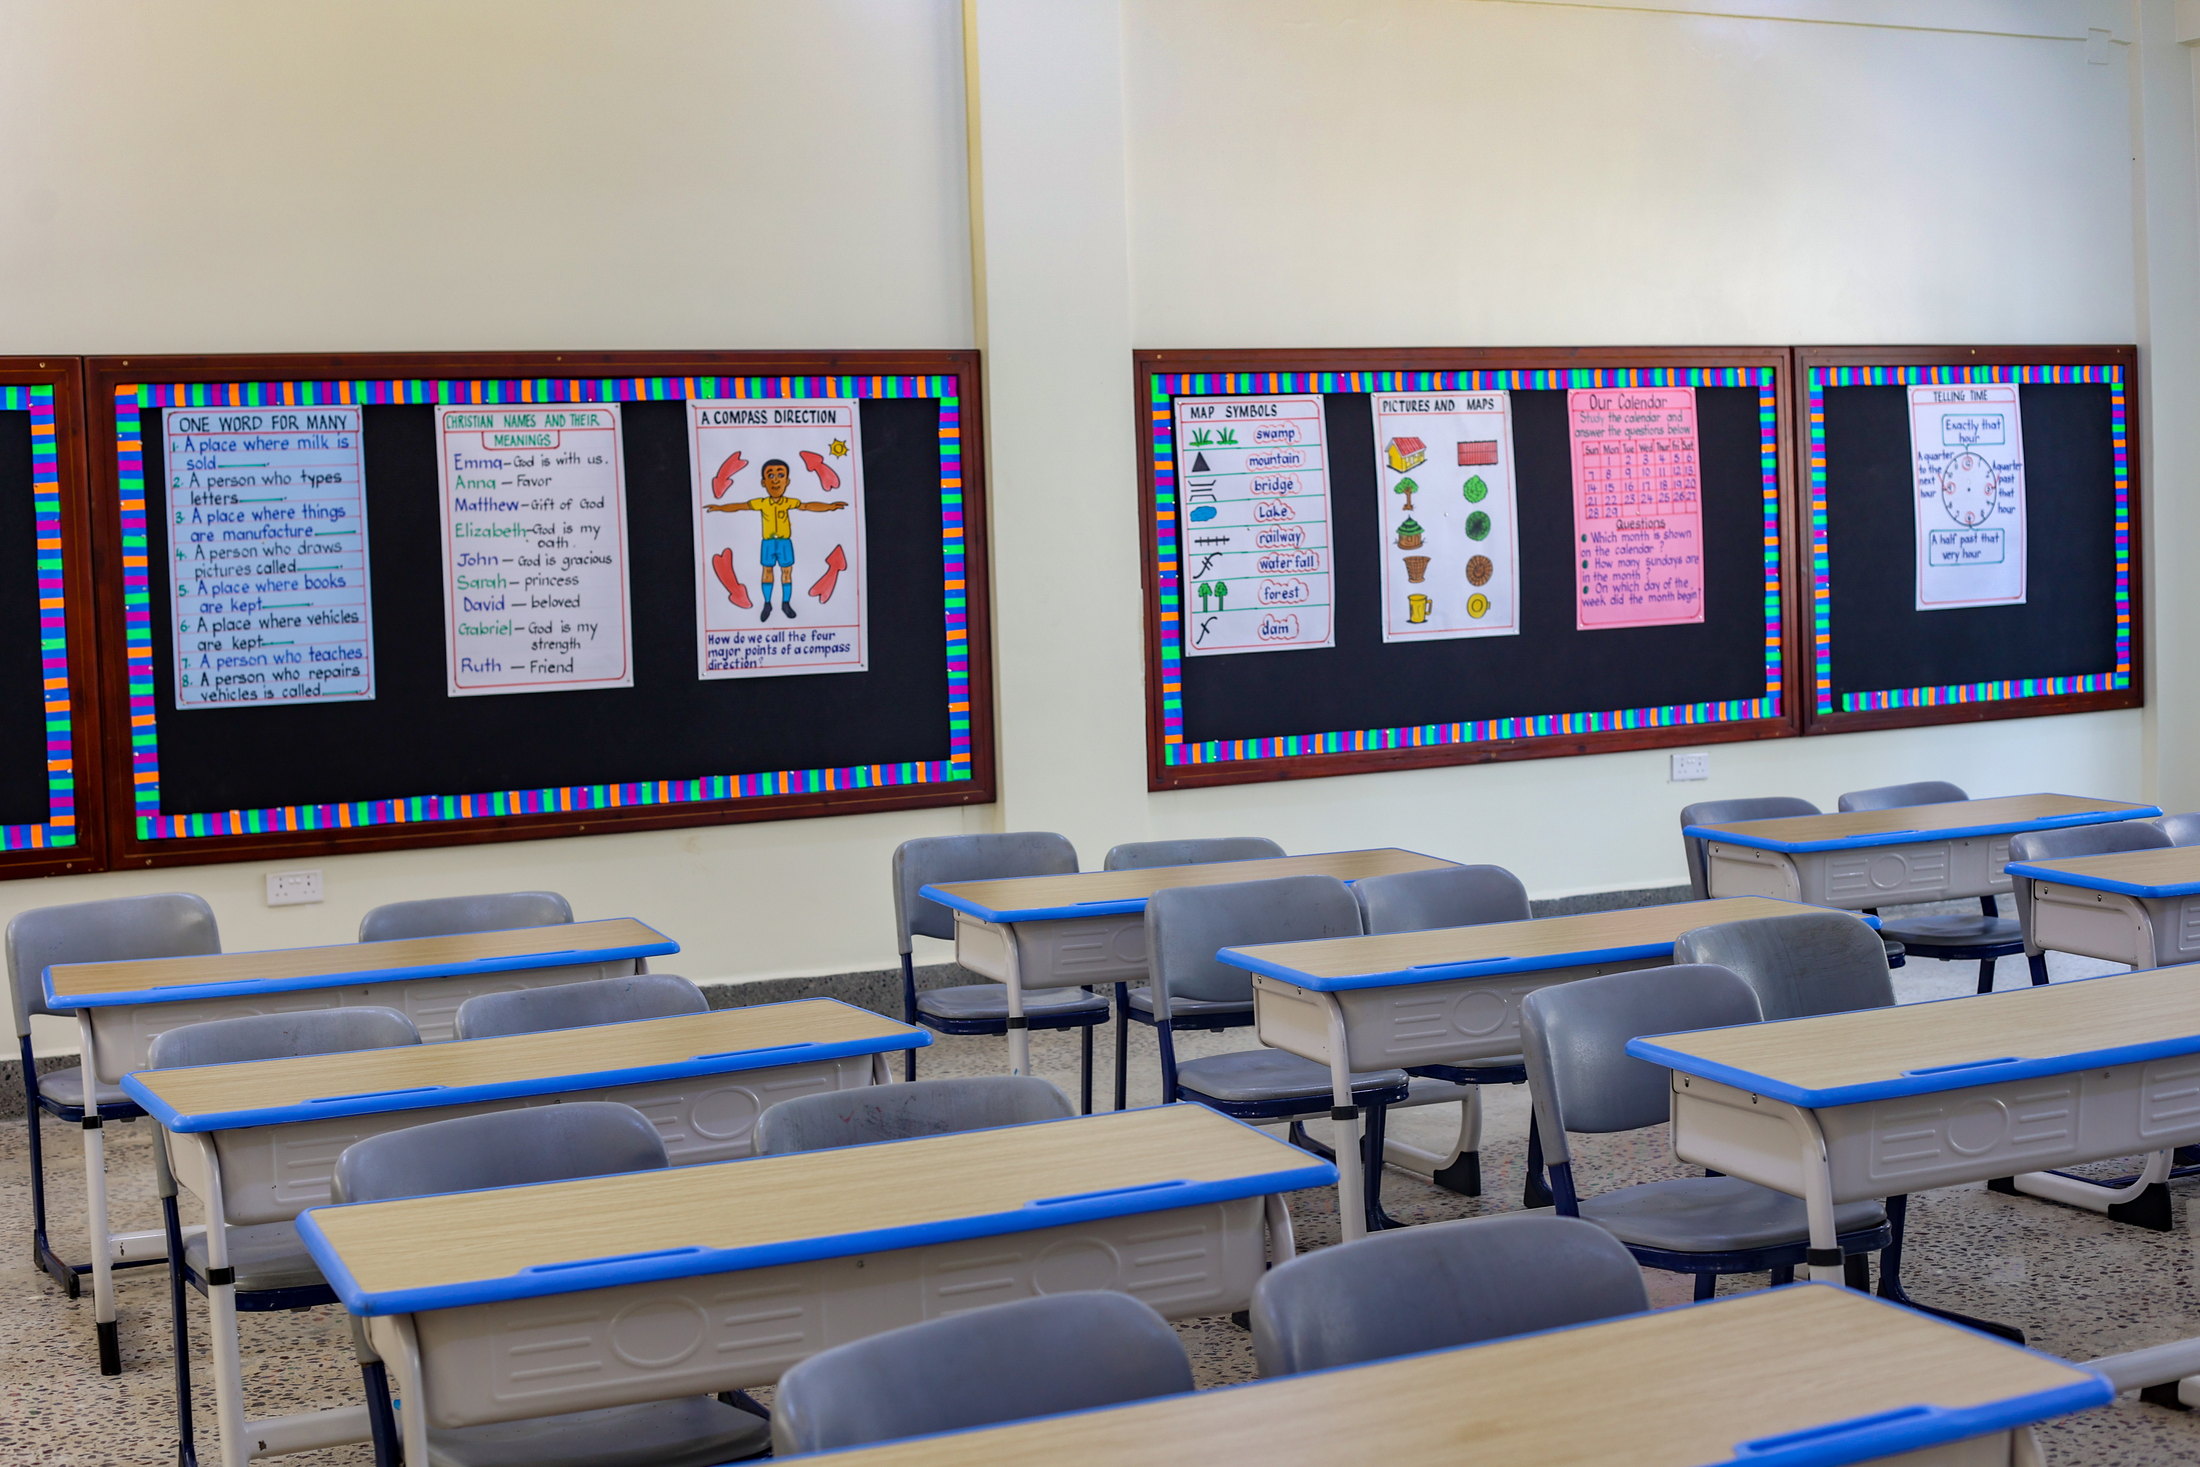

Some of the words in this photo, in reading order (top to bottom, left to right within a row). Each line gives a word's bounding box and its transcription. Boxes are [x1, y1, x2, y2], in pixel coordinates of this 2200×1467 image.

[1590, 394, 1612, 410] Our
[1618, 393, 1667, 409] Calendar
[1933, 391, 1965, 402] TELLING
[1970, 390, 1988, 401] TIME
[1191, 406, 1214, 418] MAP
[1226, 404, 1277, 418] SYMBOLS
[1383, 400, 1430, 412] PICTURES
[1435, 400, 1455, 411] AND
[1467, 399, 1494, 409] MAPS
[180, 417, 209, 432] ONE
[219, 416, 262, 431] WORD
[272, 415, 299, 430] FOR
[307, 415, 347, 430] MANY
[447, 415, 493, 428] CHRISTIAN
[504, 415, 535, 428] NAMES
[545, 414, 566, 427] AND
[570, 414, 599, 426] THEIR
[702, 412, 709, 424] A
[714, 410, 767, 424] COMPASS
[775, 410, 836, 423] DIRECTION
[1580, 411, 1604, 425] Study
[1609, 412, 1621, 422] the
[1625, 413, 1660, 423] calendar
[1667, 410, 1682, 421] and
[1575, 429, 1605, 437] answer
[1609, 425, 1621, 436] the
[1625, 426, 1664, 440] questions
[1668, 425, 1690, 434] below
[1946, 419, 1978, 435] Exactly
[1982, 419, 2001, 429] that
[494, 434, 550, 446] MEANINGS
[1257, 430, 1295, 442] swamp
[1959, 433, 1979, 442] hour
[185, 436, 195, 452] A
[200, 439, 236, 457] place
[243, 436, 288, 451] where
[298, 434, 328, 449] milk
[338, 433, 348, 448] is
[542, 454, 550, 466] is
[556, 452, 580, 465] with
[1250, 453, 1299, 466] mountain
[189, 473, 200, 487] A
[208, 475, 255, 491] person
[262, 471, 291, 485] who
[302, 470, 342, 488] types
[456, 475, 496, 489] Anna
[517, 474, 552, 487] Favor
[1255, 478, 1293, 494] bridge
[560, 498, 571, 509] of
[580, 497, 604, 508] God
[192, 508, 202, 523] A
[207, 510, 244, 525] place
[252, 506, 295, 521] where
[302, 504, 345, 521] things
[563, 522, 572, 534] is
[581, 524, 600, 539] my
[1616, 519, 1665, 529] Questions
[191, 531, 214, 542] are
[1260, 529, 1301, 547] railway
[1591, 532, 1617, 543] Which
[1622, 532, 1649, 541] month
[1654, 531, 1660, 539] is
[1664, 529, 1691, 540] shown
[1932, 534, 1937, 545] A
[1940, 533, 1956, 544] half
[1960, 533, 1977, 548] past
[1981, 533, 1999, 543] that
[195, 545, 205, 560] A
[209, 546, 257, 563] person
[263, 542, 291, 555] who
[298, 540, 342, 554] draws
[1596, 546, 1610, 556] the
[1616, 544, 1653, 554] calendar
[1943, 551, 1959, 562] very
[1963, 548, 1981, 558] hour
[457, 553, 498, 567] John
[518, 556, 540, 566] God
[546, 554, 556, 565] is
[563, 551, 612, 571] gracious
[1595, 558, 1612, 568] How
[1618, 560, 1640, 569] many
[1686, 555, 1699, 564] are
[195, 565, 251, 581] pictures
[198, 580, 207, 595] A
[212, 582, 249, 598] place
[256, 579, 298, 593] where
[305, 574, 346, 589] books
[525, 574, 579, 591] princess
[1595, 583, 1608, 593] On
[1613, 582, 1639, 592] which
[1265, 587, 1299, 600] forest
[200, 601, 222, 613] are
[464, 595, 504, 612] David
[532, 595, 580, 608] beloved
[197, 618, 207, 633] A
[213, 619, 250, 637] place
[259, 614, 301, 629] where
[307, 610, 359, 625] vehicles
[459, 620, 512, 636] Gabriel
[528, 621, 552, 634] God
[561, 621, 571, 633] is
[577, 623, 598, 640] my
[1262, 621, 1288, 635] dam
[708, 635, 729, 645] How
[734, 632, 744, 644] do
[748, 635, 762, 643] we
[766, 631, 784, 643] call
[789, 631, 806, 642] the
[811, 630, 835, 641] four
[198, 640, 222, 651] are
[531, 638, 580, 654] strength
[708, 649, 740, 660] major
[745, 645, 776, 659] points
[781, 645, 792, 654] of
[794, 646, 801, 654] a
[804, 643, 850, 657] compass
[201, 654, 210, 669] A
[217, 655, 267, 670] person
[273, 650, 301, 665] who
[309, 646, 362, 660] teaches
[462, 658, 501, 672] Ruth
[530, 657, 573, 673] Friend
[201, 672, 209, 687] A
[216, 671, 264, 690] person
[272, 669, 300, 681] who
[309, 663, 360, 682] repairs
[201, 689, 257, 702] vehicles
[264, 686, 274, 698] is
